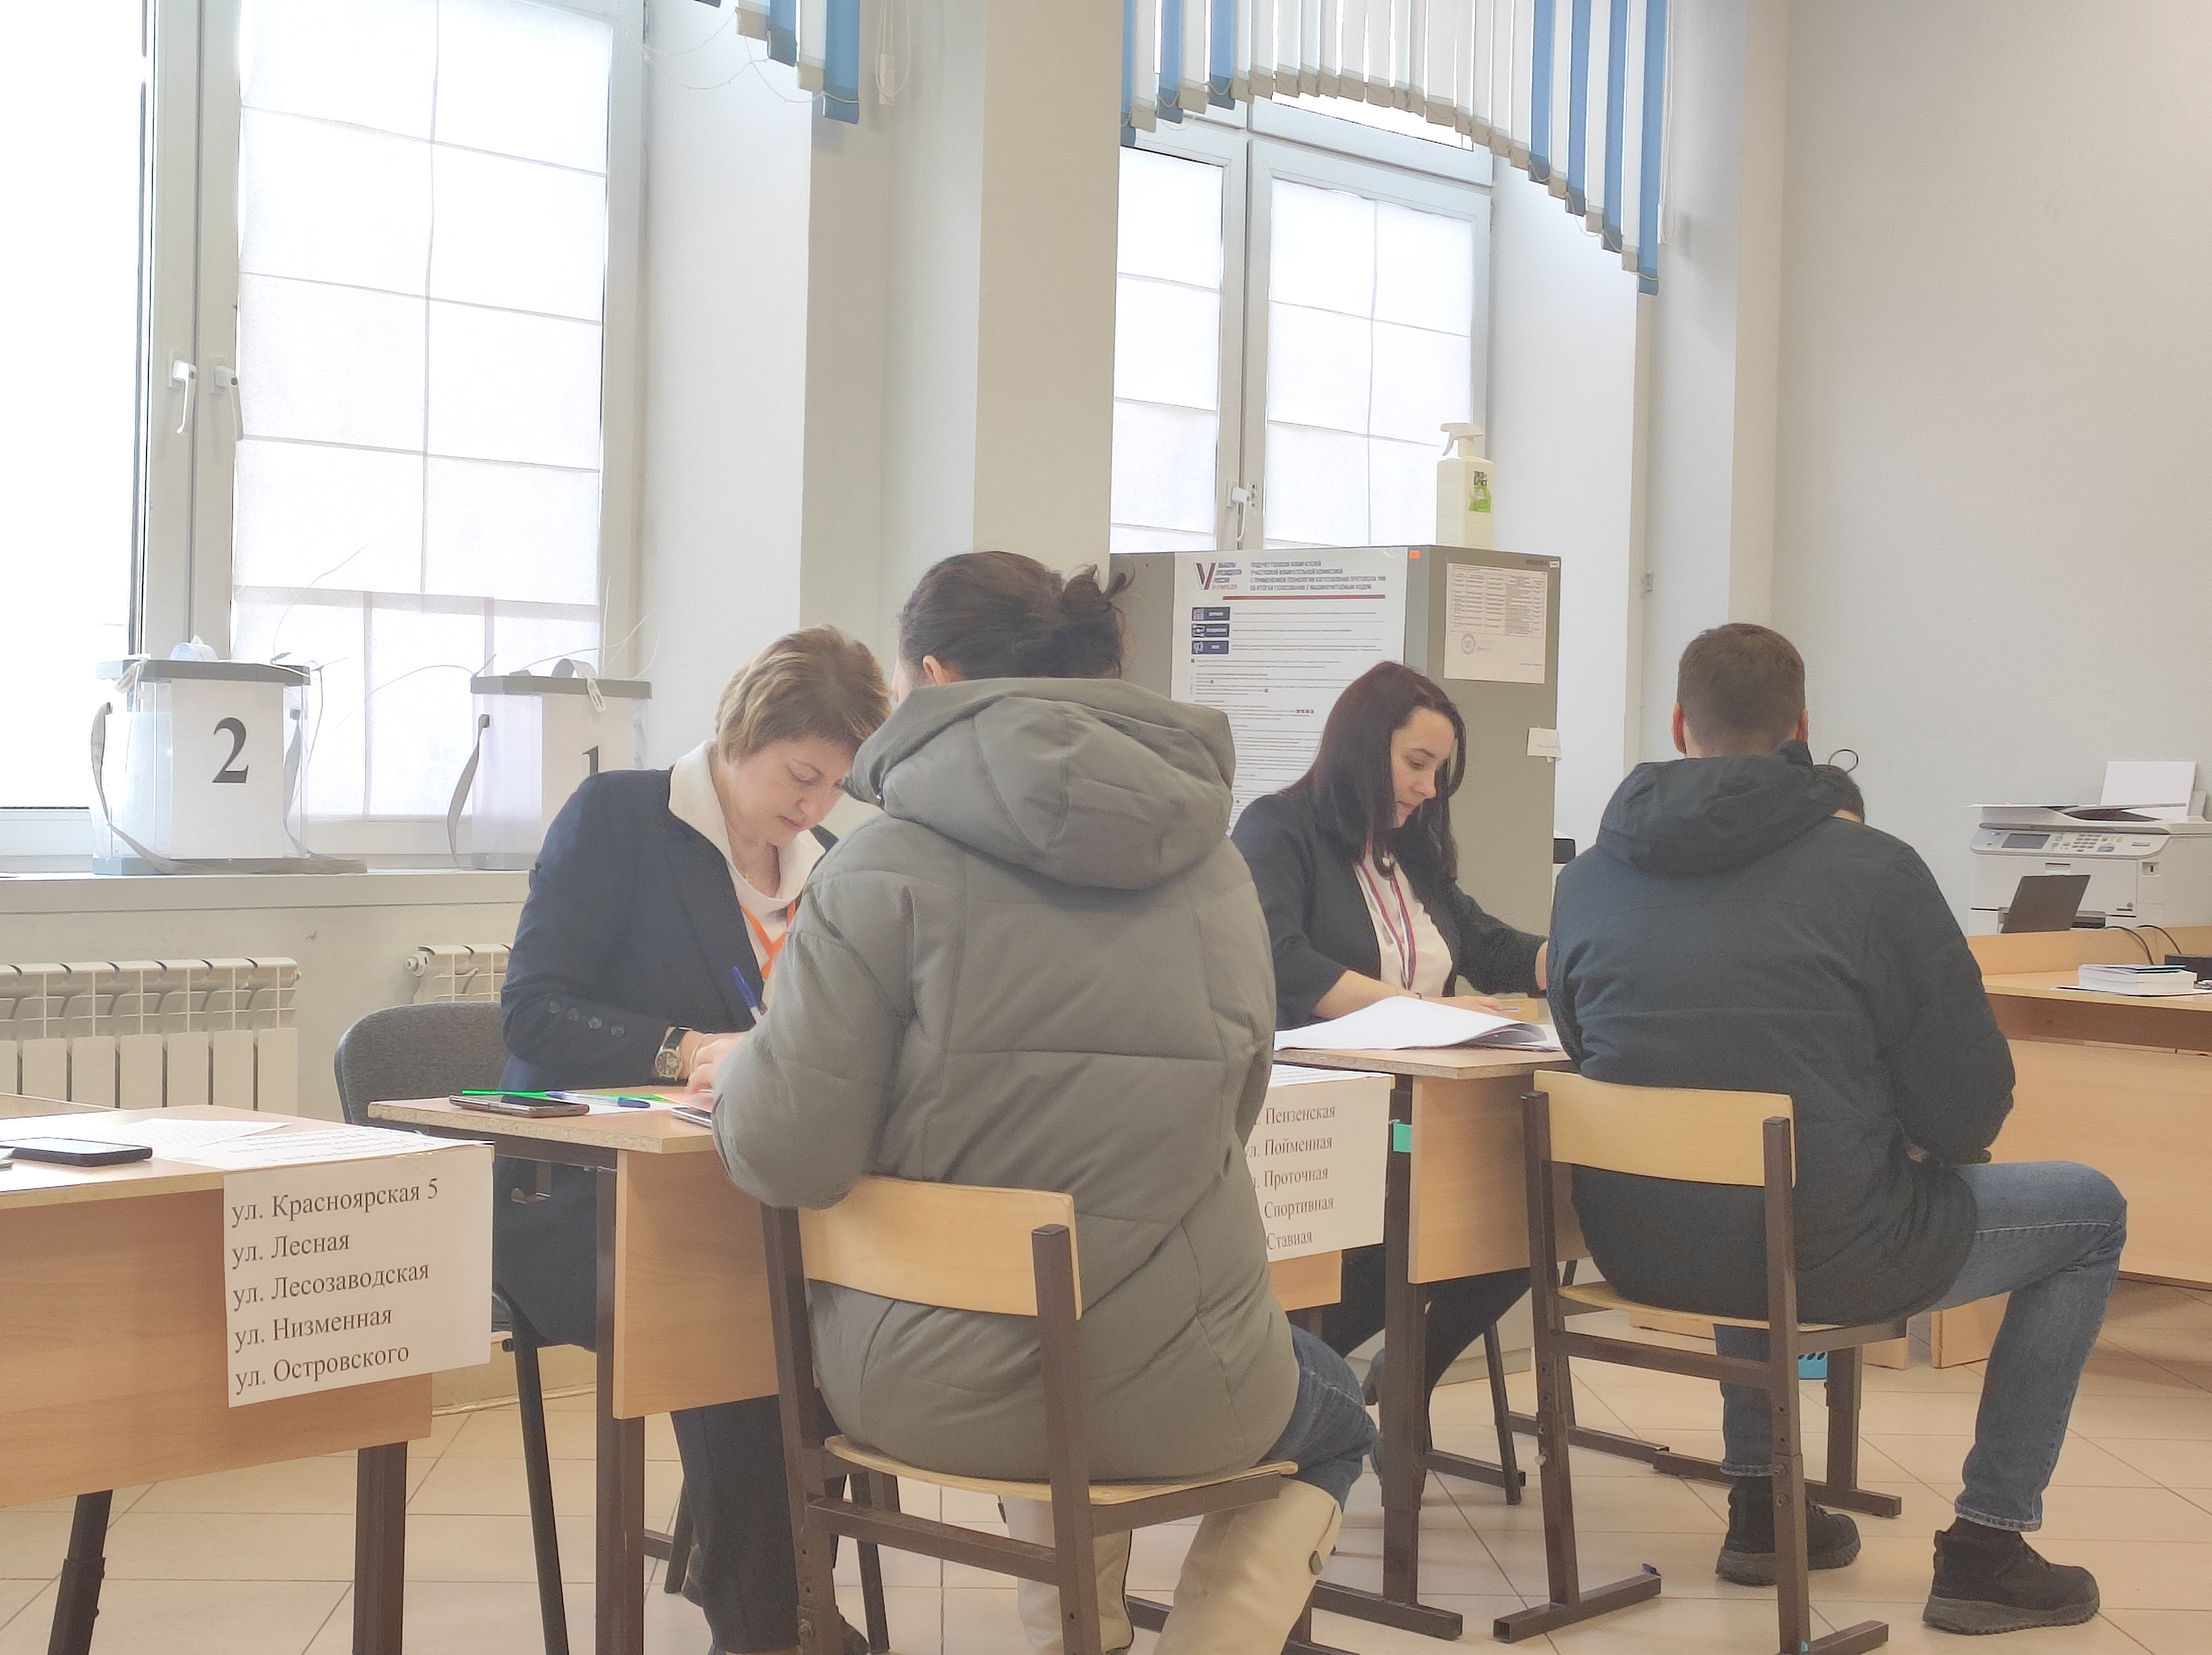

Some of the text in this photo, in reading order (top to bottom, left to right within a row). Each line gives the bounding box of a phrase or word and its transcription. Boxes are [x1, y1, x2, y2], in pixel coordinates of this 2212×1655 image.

[212, 717, 249, 783] 2
[1266, 1106, 1335, 1124] Пензенская
[1265, 1137, 1332, 1156] Пойменная
[1264, 1167, 1328, 1190] Проточная
[232, 1177, 438, 1228] ул. Красноярская 5
[1264, 1197, 1334, 1220] Спортивная
[232, 1234, 350, 1269] ул. Лесная
[1267, 1231, 1312, 1250] Ставная
[233, 1264, 430, 1311] ул. Лесозаводская
[235, 1309, 392, 1353] ул. Низменная
[236, 1346, 409, 1395] ул. Островского
